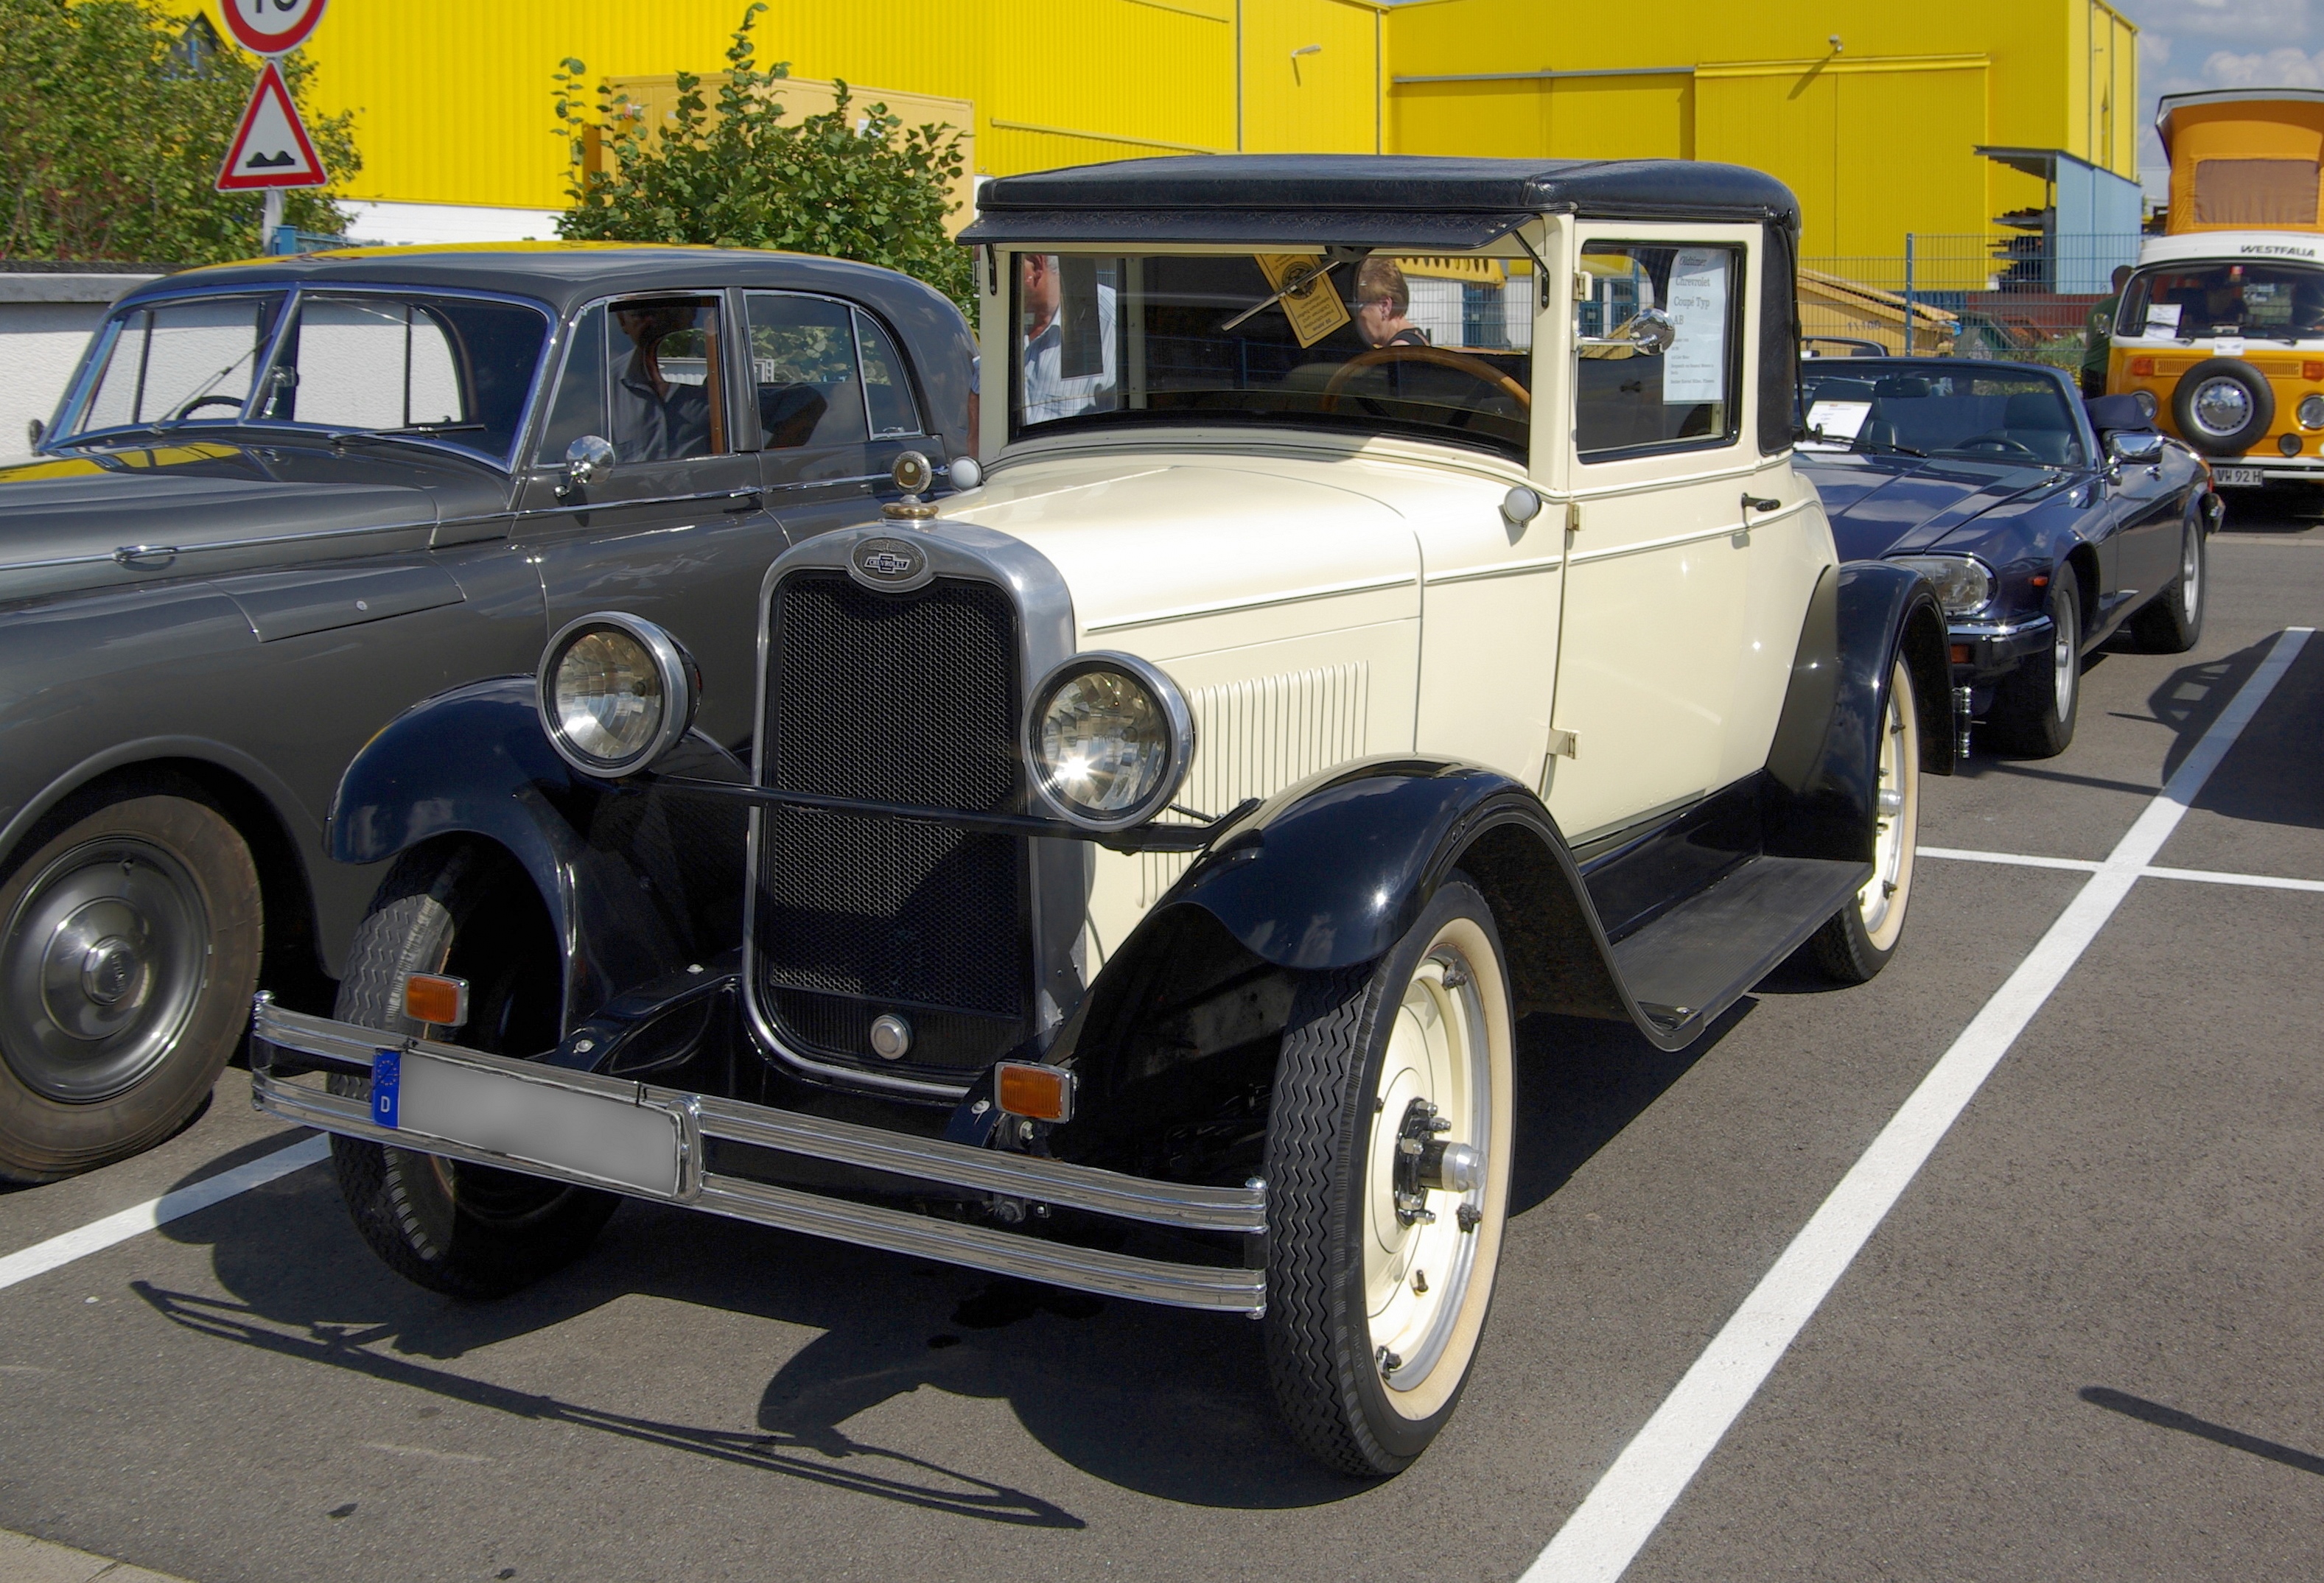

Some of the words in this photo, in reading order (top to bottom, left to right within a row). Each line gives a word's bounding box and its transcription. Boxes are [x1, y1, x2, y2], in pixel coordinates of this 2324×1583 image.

[2240, 245, 2316, 257] WESTFALIA
[1679, 256, 1707, 266] Oldtimer
[1676, 275, 1710, 287] Chrevrolet
[1674, 296, 1694, 309] Coupé
[1696, 297, 1710, 309] Typ
[1673, 315, 1684, 325] AB
[869, 559, 906, 568] CHEVROLET
[380, 1095, 391, 1113] D
